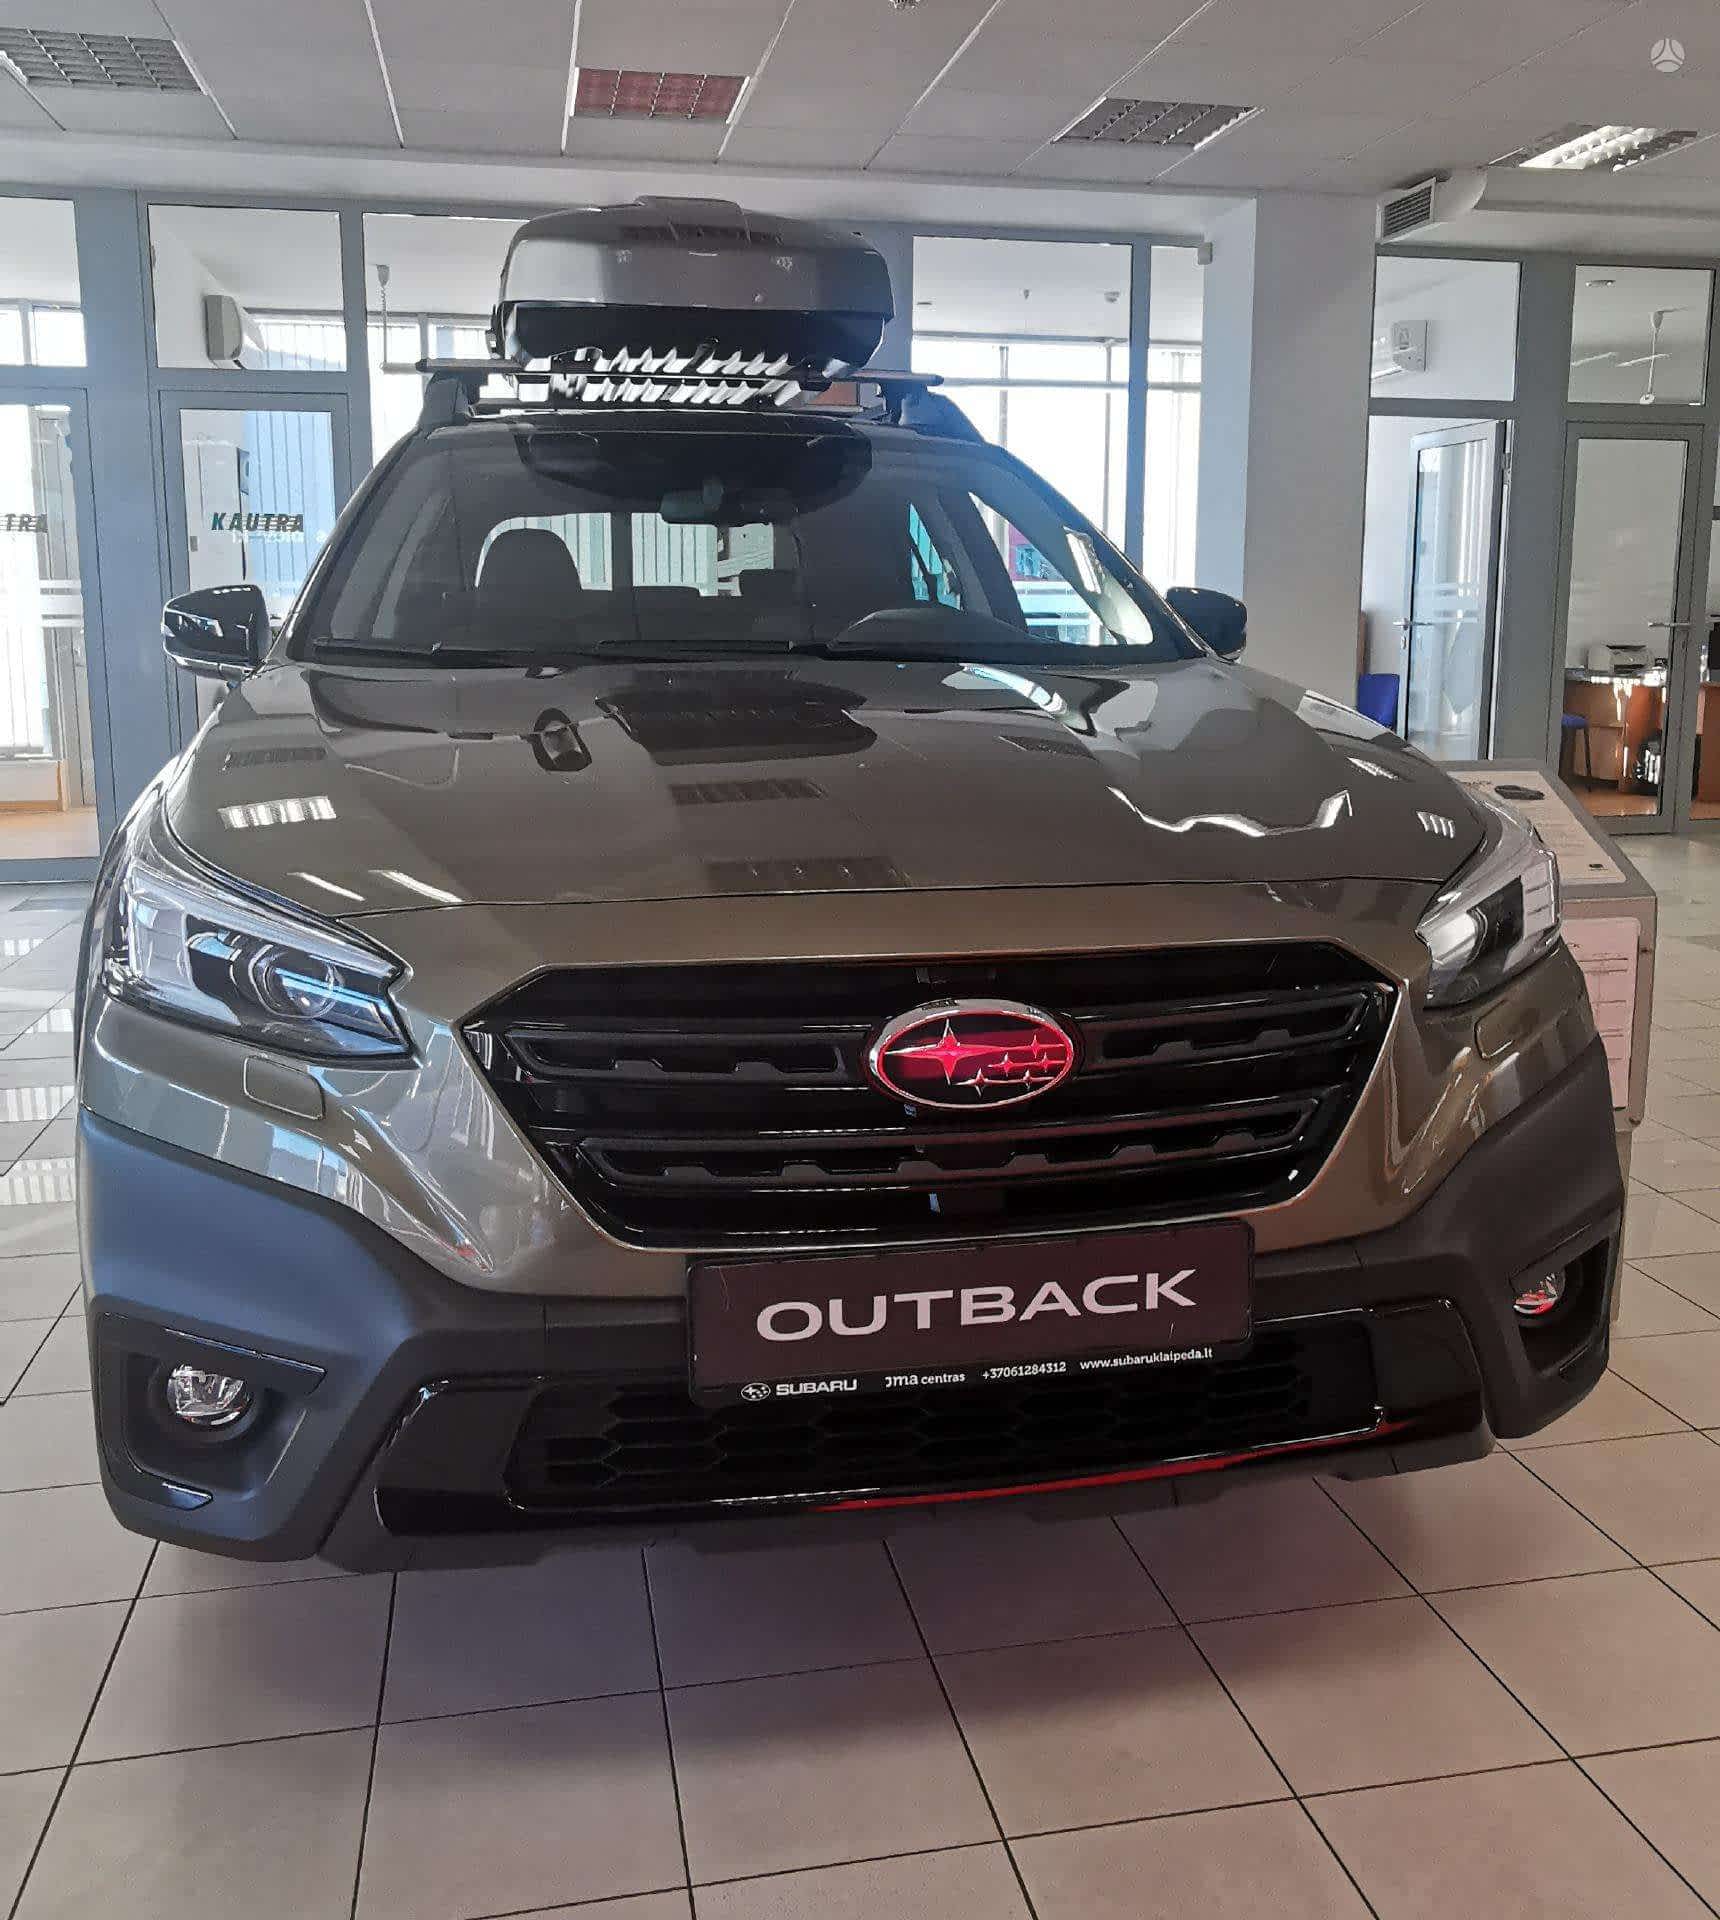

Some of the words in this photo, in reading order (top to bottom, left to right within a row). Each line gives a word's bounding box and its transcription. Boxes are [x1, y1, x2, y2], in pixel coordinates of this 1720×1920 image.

[211, 512, 304, 533] KAUTRA
[756, 1268, 1197, 1341] OUTBACK
[775, 1378, 858, 1396] SUBARU
[920, 1372, 966, 1385] centras
[982, 1361, 1067, 1380] +37061284312
[1079, 1347, 1213, 1370] www.subaruklaipeda.lt
